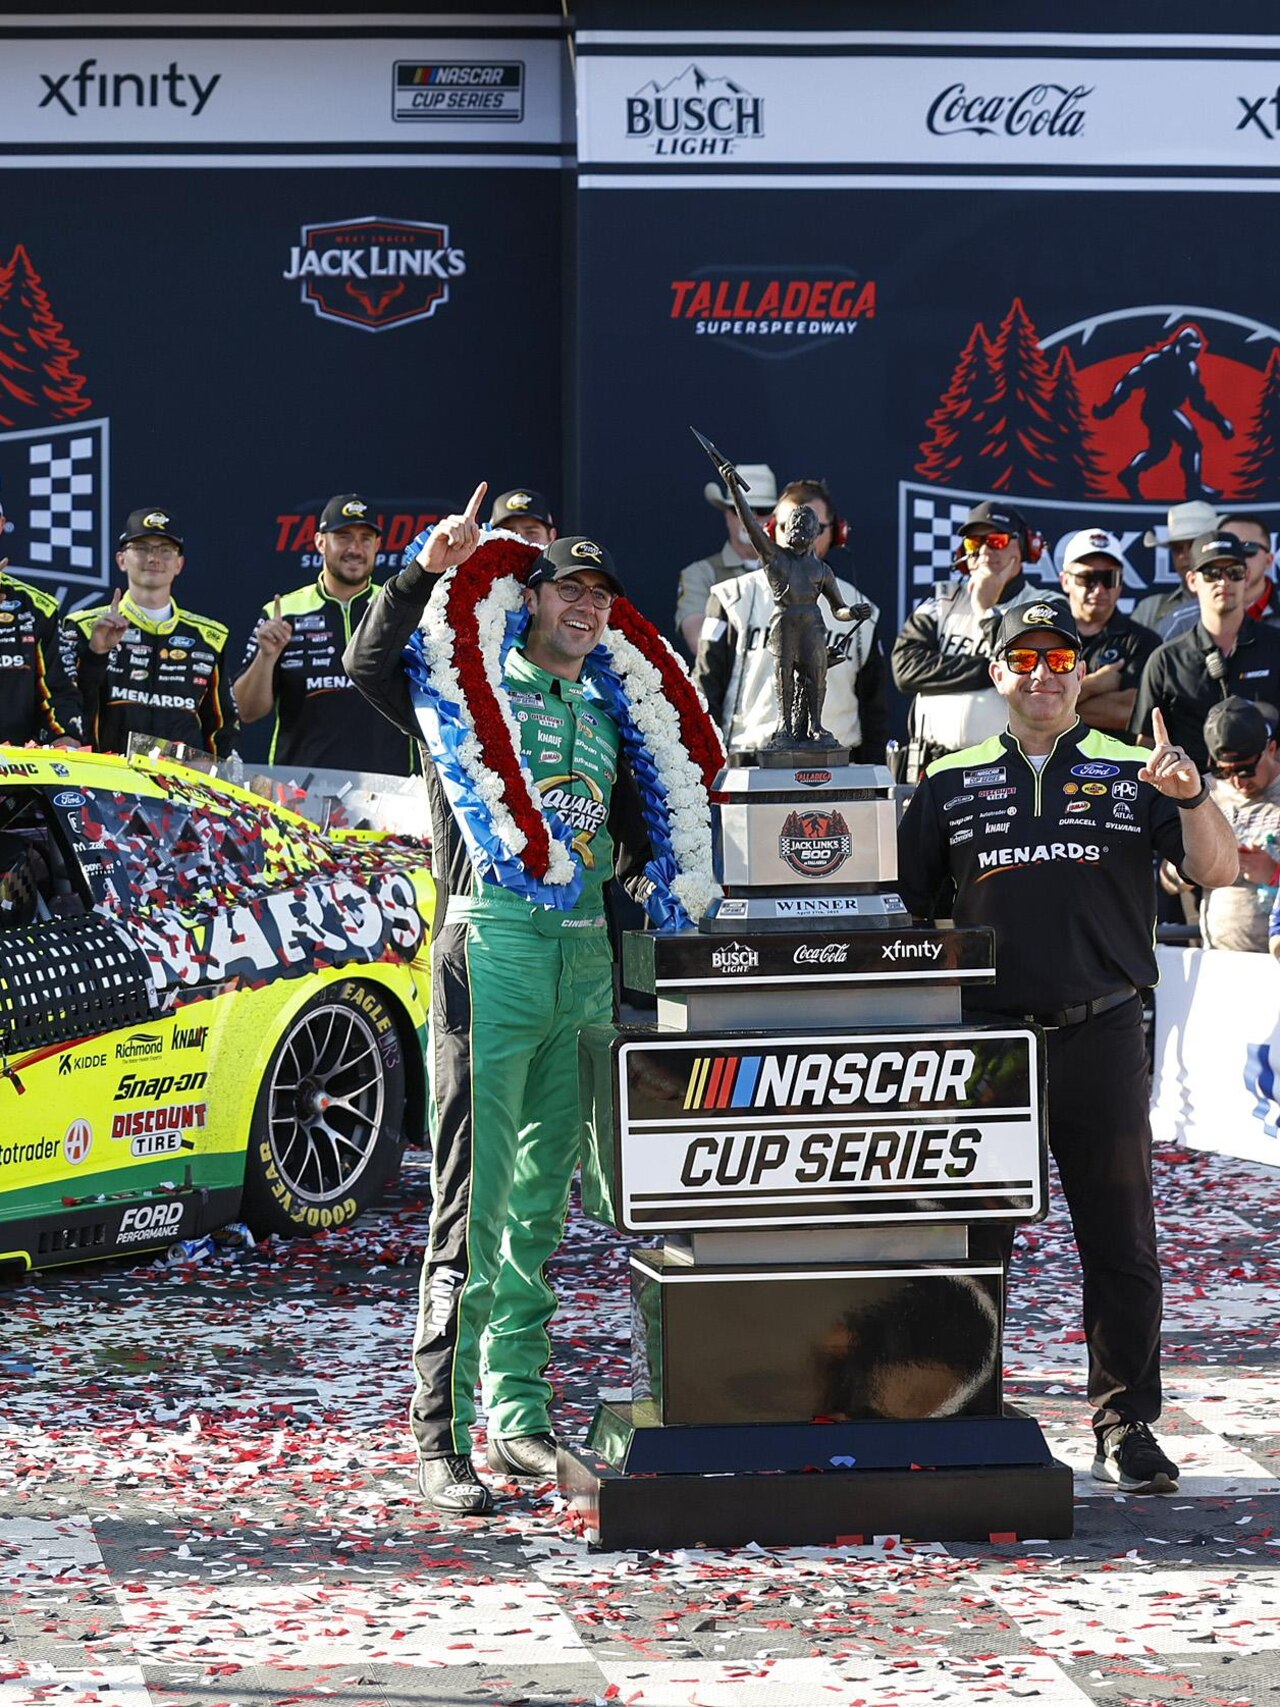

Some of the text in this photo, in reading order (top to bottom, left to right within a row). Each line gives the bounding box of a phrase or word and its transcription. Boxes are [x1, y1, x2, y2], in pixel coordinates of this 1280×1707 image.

[434, 66, 504, 86] NASCAR
[38, 58, 222, 117] xfinity
[411, 91, 504, 109] CUP SERIES
[625, 97, 765, 138] BUSCH
[925, 82, 1095, 139] Coca-Cola
[654, 138, 734, 156] LIGHT
[283, 246, 467, 281] JACK LINK'S
[670, 280, 876, 319] TALLADEGA
[695, 320, 859, 335] SUPERSPEEDWAY
[111, 685, 196, 709] MENARDS
[537, 729, 563, 748] KNAUF
[1079, 765, 1110, 777] Ford
[61, 793, 81, 805] Ford
[978, 787, 1016, 798] DISCOUNT
[1114, 783, 1136, 798] PPG
[979, 809, 1007, 818] Autotrader
[1059, 818, 1097, 826] DURACELL
[1114, 811, 1135, 820] ATLAS
[985, 821, 1011, 834] KNAUF
[1105, 821, 1141, 833] SYLVANIA
[790, 841, 813, 851] JACK
[801, 850, 832, 860] 500
[977, 842, 1100, 869] MENARDS
[776, 899, 858, 912] WINNER
[711, 950, 759, 968] BUSCH
[793, 943, 851, 964] Coca-Cola
[881, 940, 943, 961] xfinity
[722, 965, 749, 973] LIGHT
[342, 982, 392, 1034] EAGLE
[115, 1035, 163, 1059] Richmond
[73, 1053, 108, 1071] KIDDE
[113, 1071, 208, 1101] Snap-on
[754, 1049, 976, 1108] NASCAR
[112, 1103, 208, 1138] DISCOUNT
[135, 1133, 178, 1155] TIRE
[679, 1128, 982, 1188] CUP SERIES
[119, 1202, 184, 1232] FORD
[116, 1224, 180, 1245] PERFORMANCE
[426, 1265, 465, 1337] KNAUF
